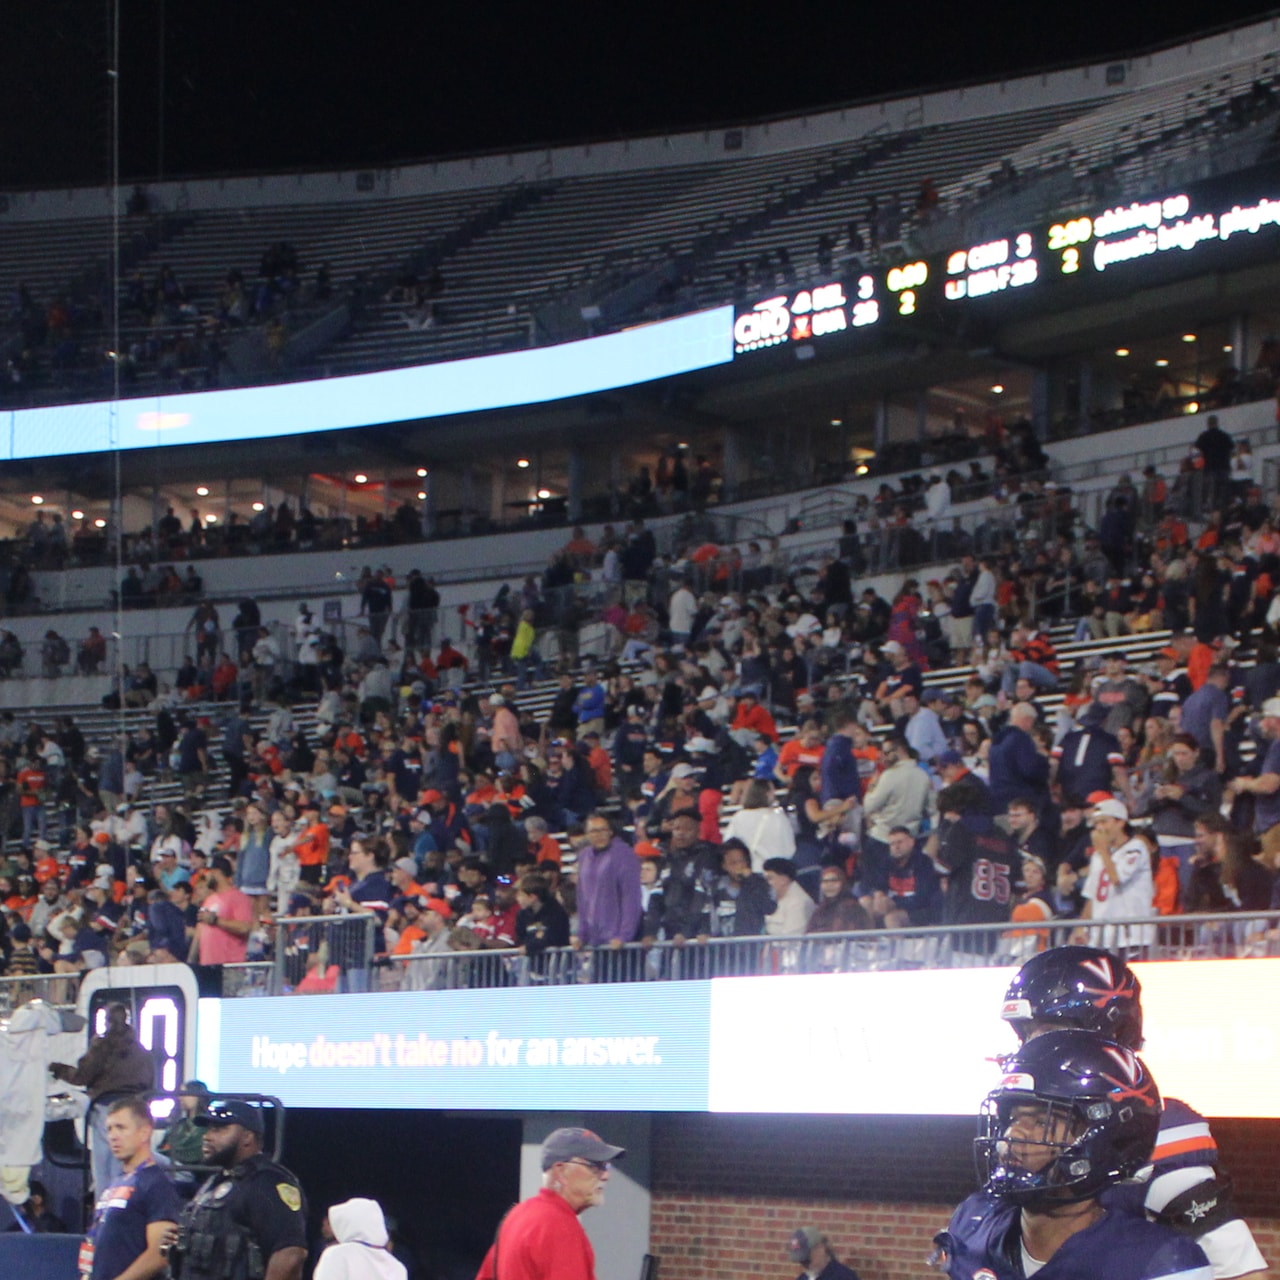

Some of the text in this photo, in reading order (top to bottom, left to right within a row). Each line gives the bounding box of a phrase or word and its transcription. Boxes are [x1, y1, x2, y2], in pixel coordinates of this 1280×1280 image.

[252, 1030, 663, 1074] Hope doesn't take no for an answer.
